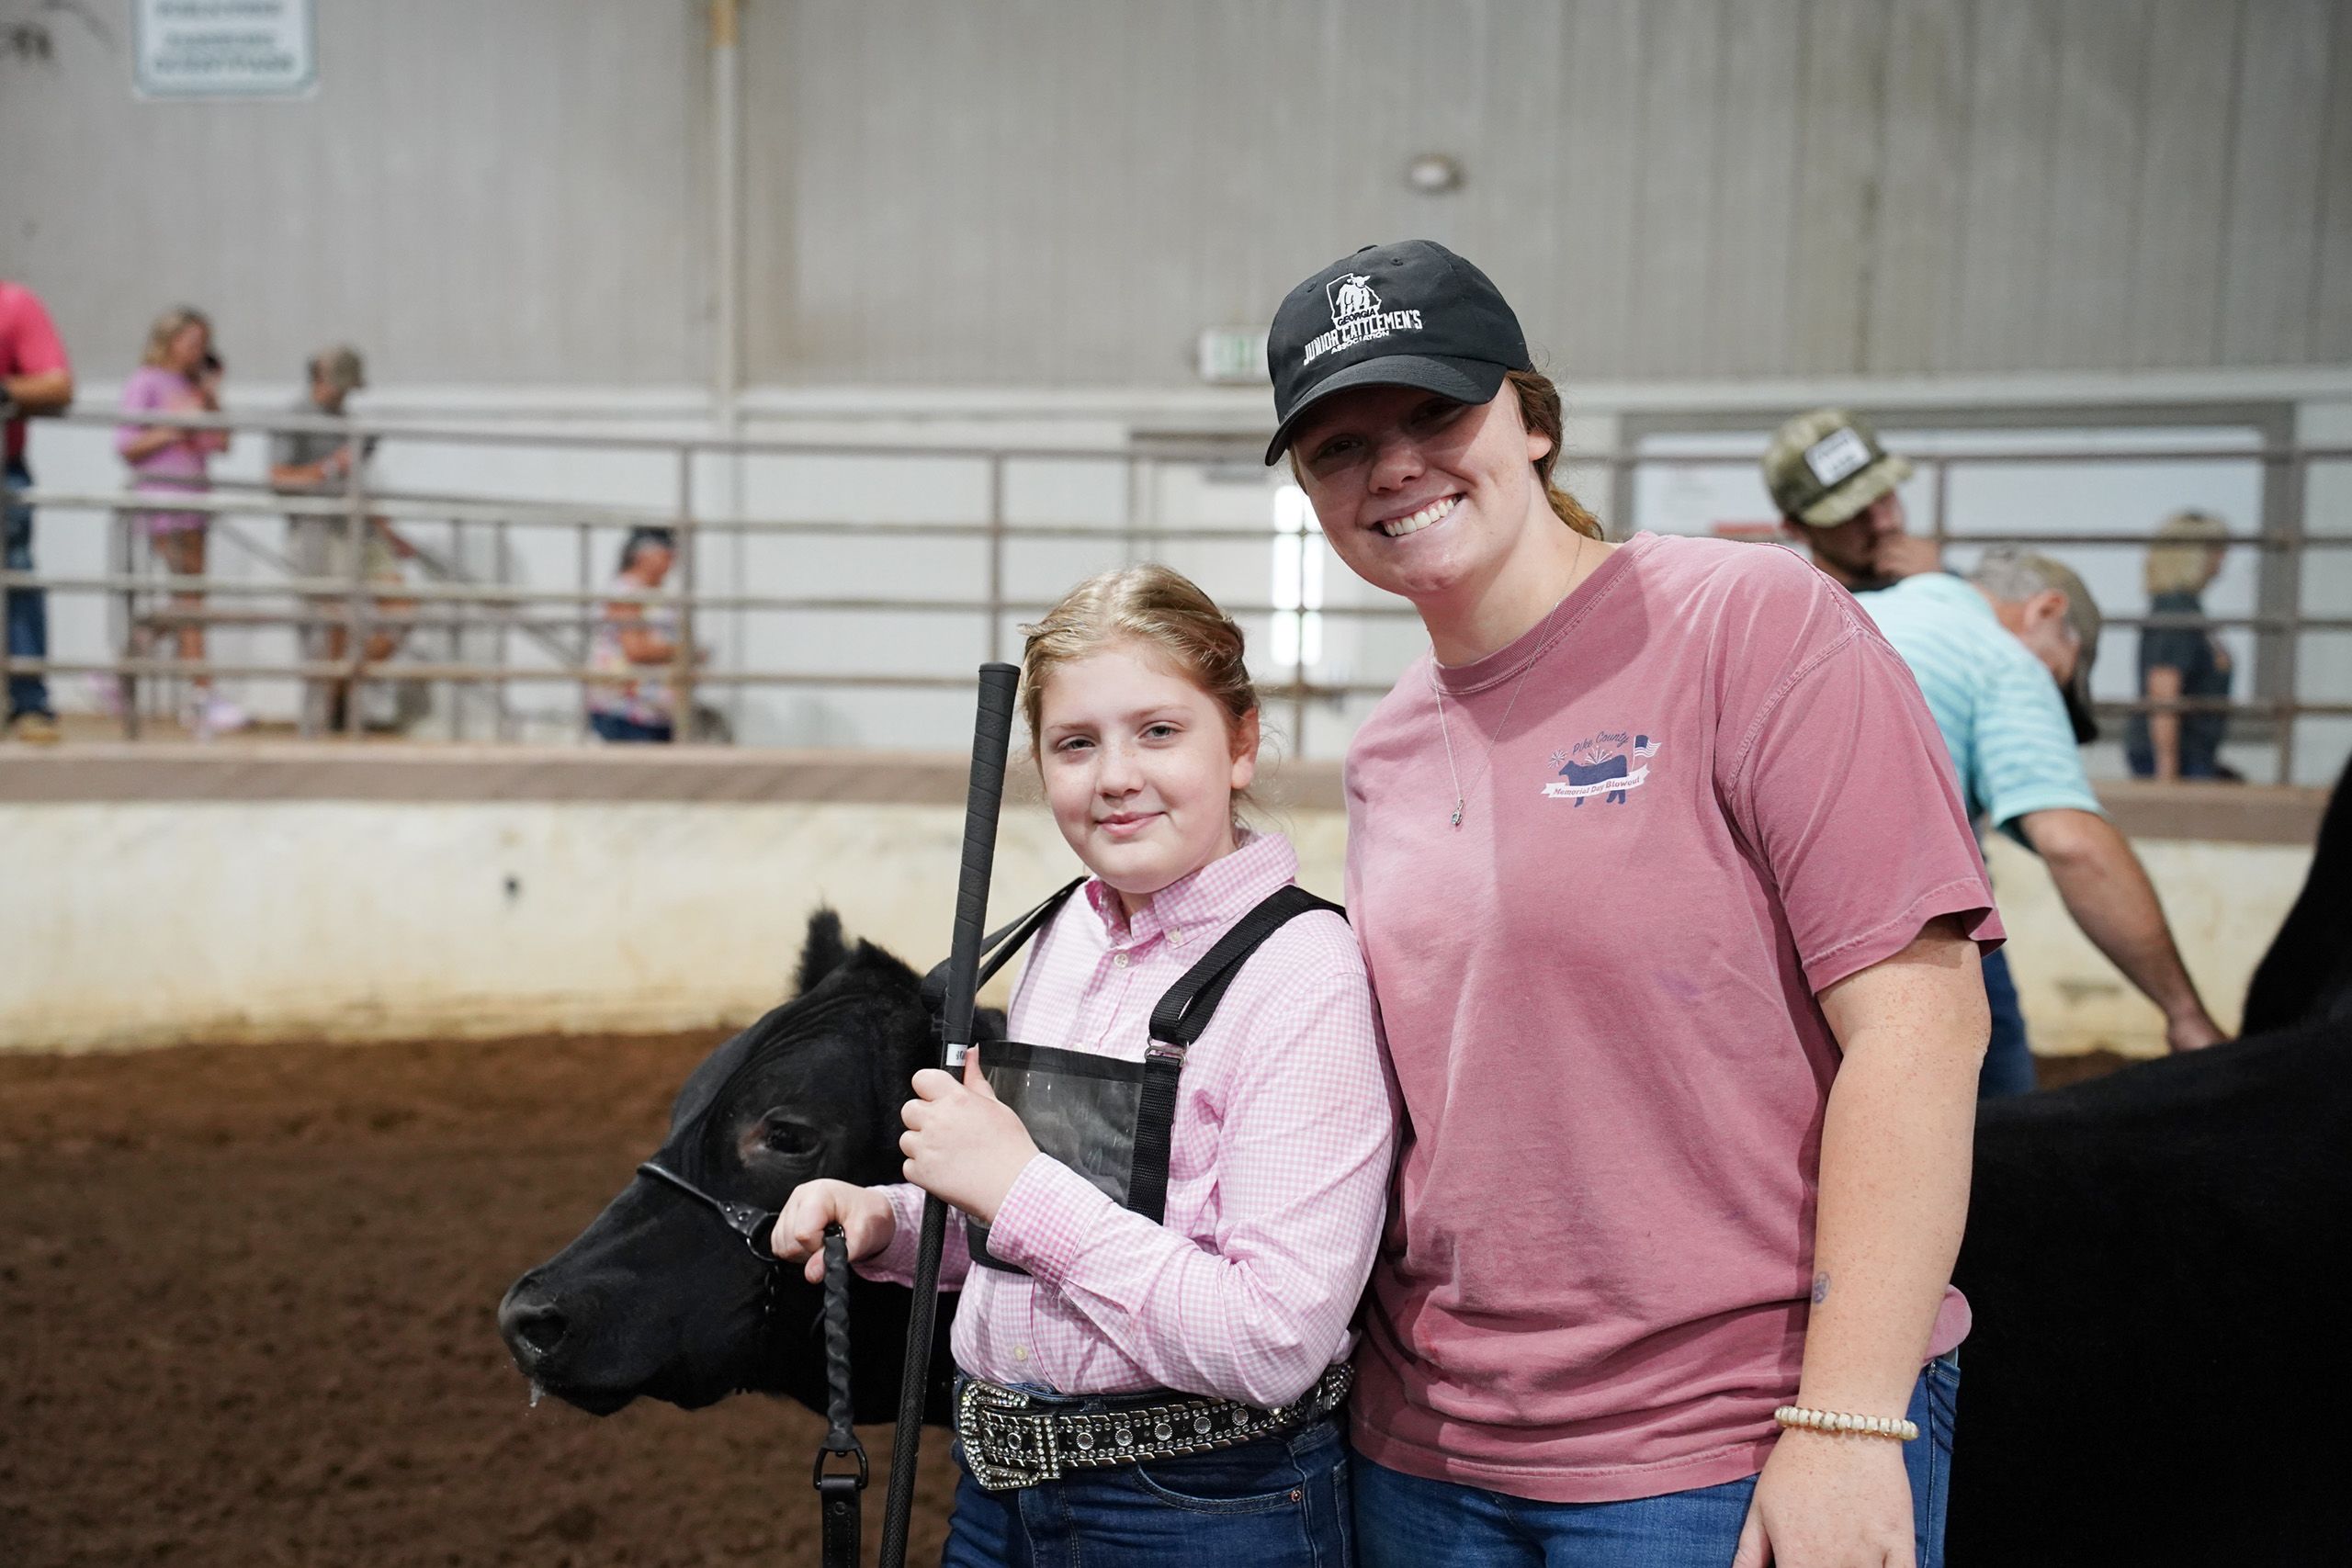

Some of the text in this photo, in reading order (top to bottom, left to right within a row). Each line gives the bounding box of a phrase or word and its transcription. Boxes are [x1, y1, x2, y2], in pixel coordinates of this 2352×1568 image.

[1337, 308, 1376, 326] GEORGIA
[1304, 310, 1422, 366] JUNIOR CATTLEMEN'S
[1330, 330, 1390, 355] ASSOCIATION
[1572, 731, 1630, 755] Pike County
[1553, 776, 1640, 795] Memorial Day Blowout
